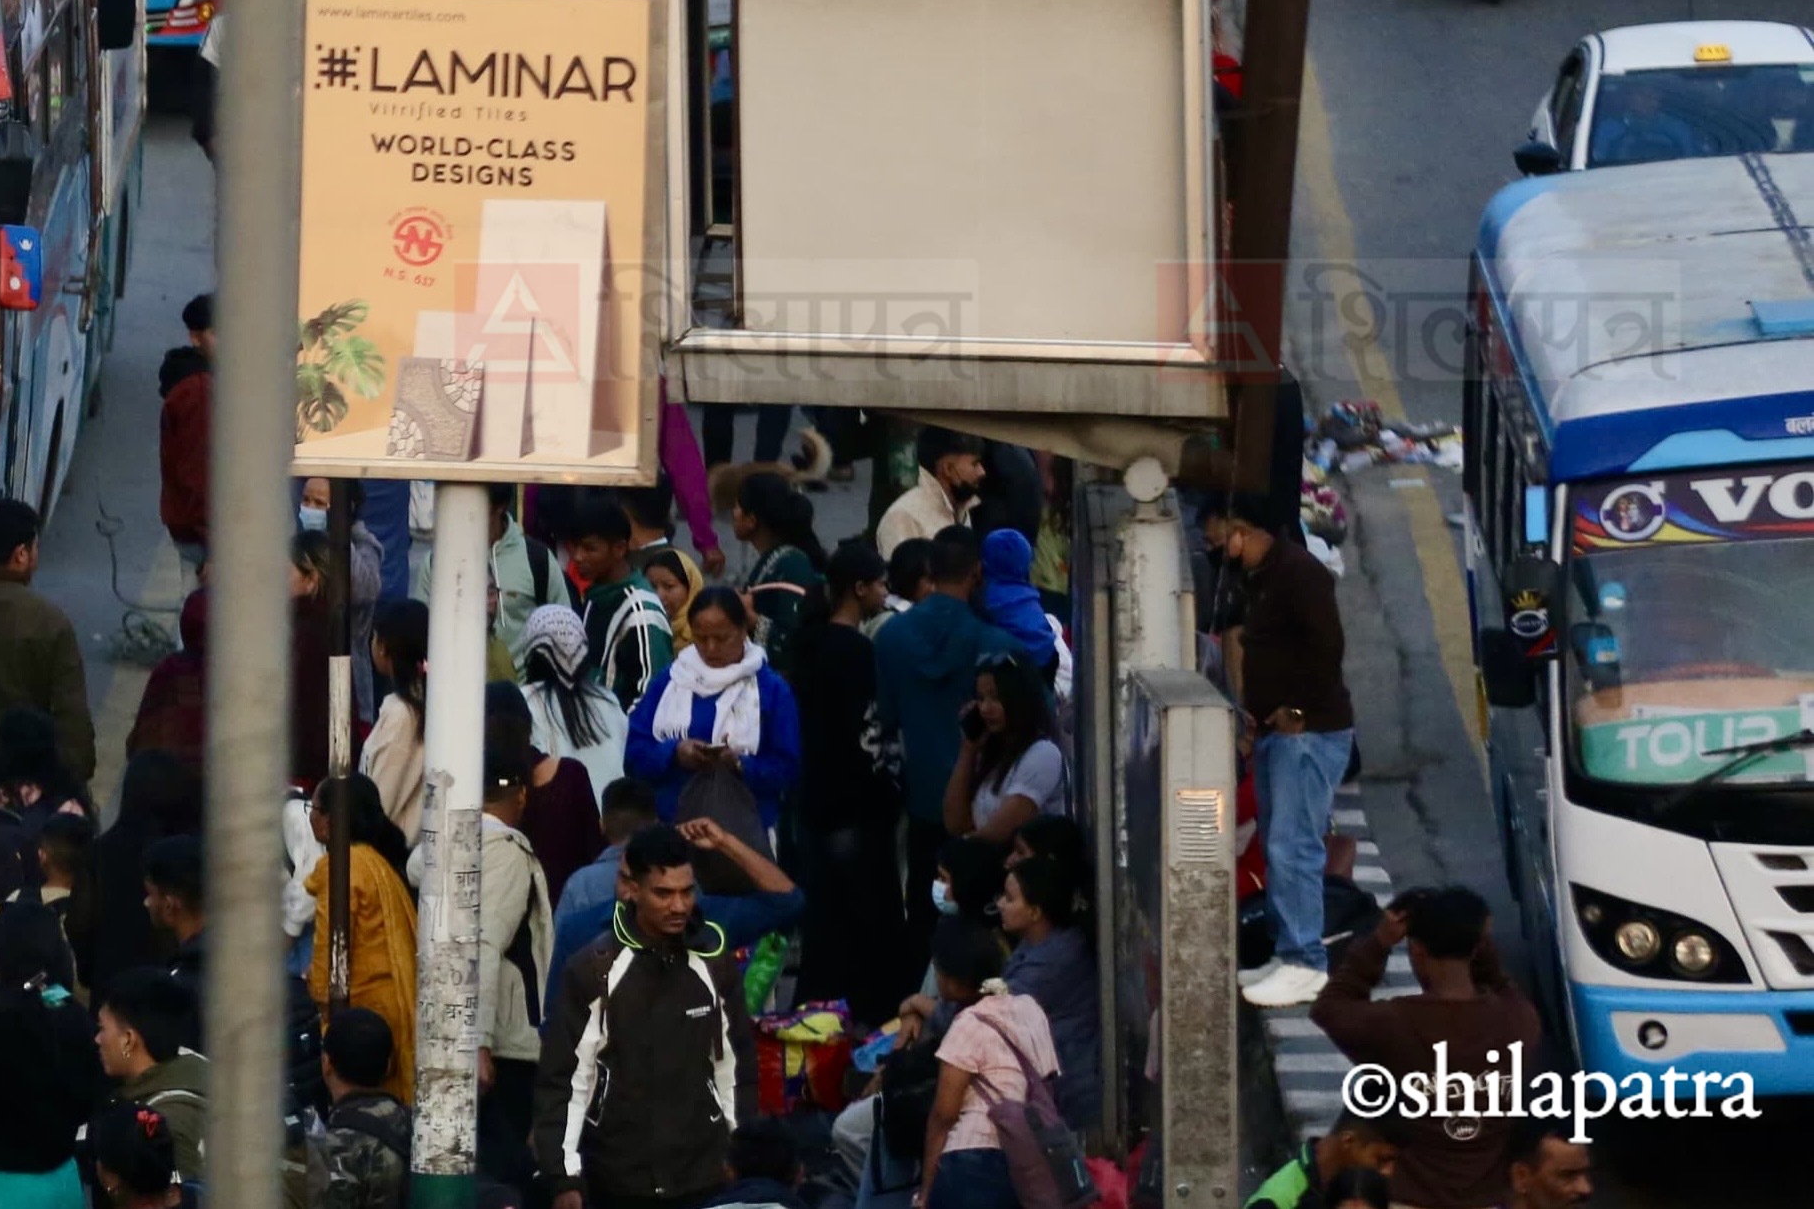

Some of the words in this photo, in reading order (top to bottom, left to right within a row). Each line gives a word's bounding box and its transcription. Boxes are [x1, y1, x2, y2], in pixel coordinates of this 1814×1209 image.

[369, 102, 463, 123] Vitrified
[474, 105, 528, 123] Tiles
[371, 133, 576, 163] WORLD-CLASS
[412, 162, 534, 188] DESIGNS
